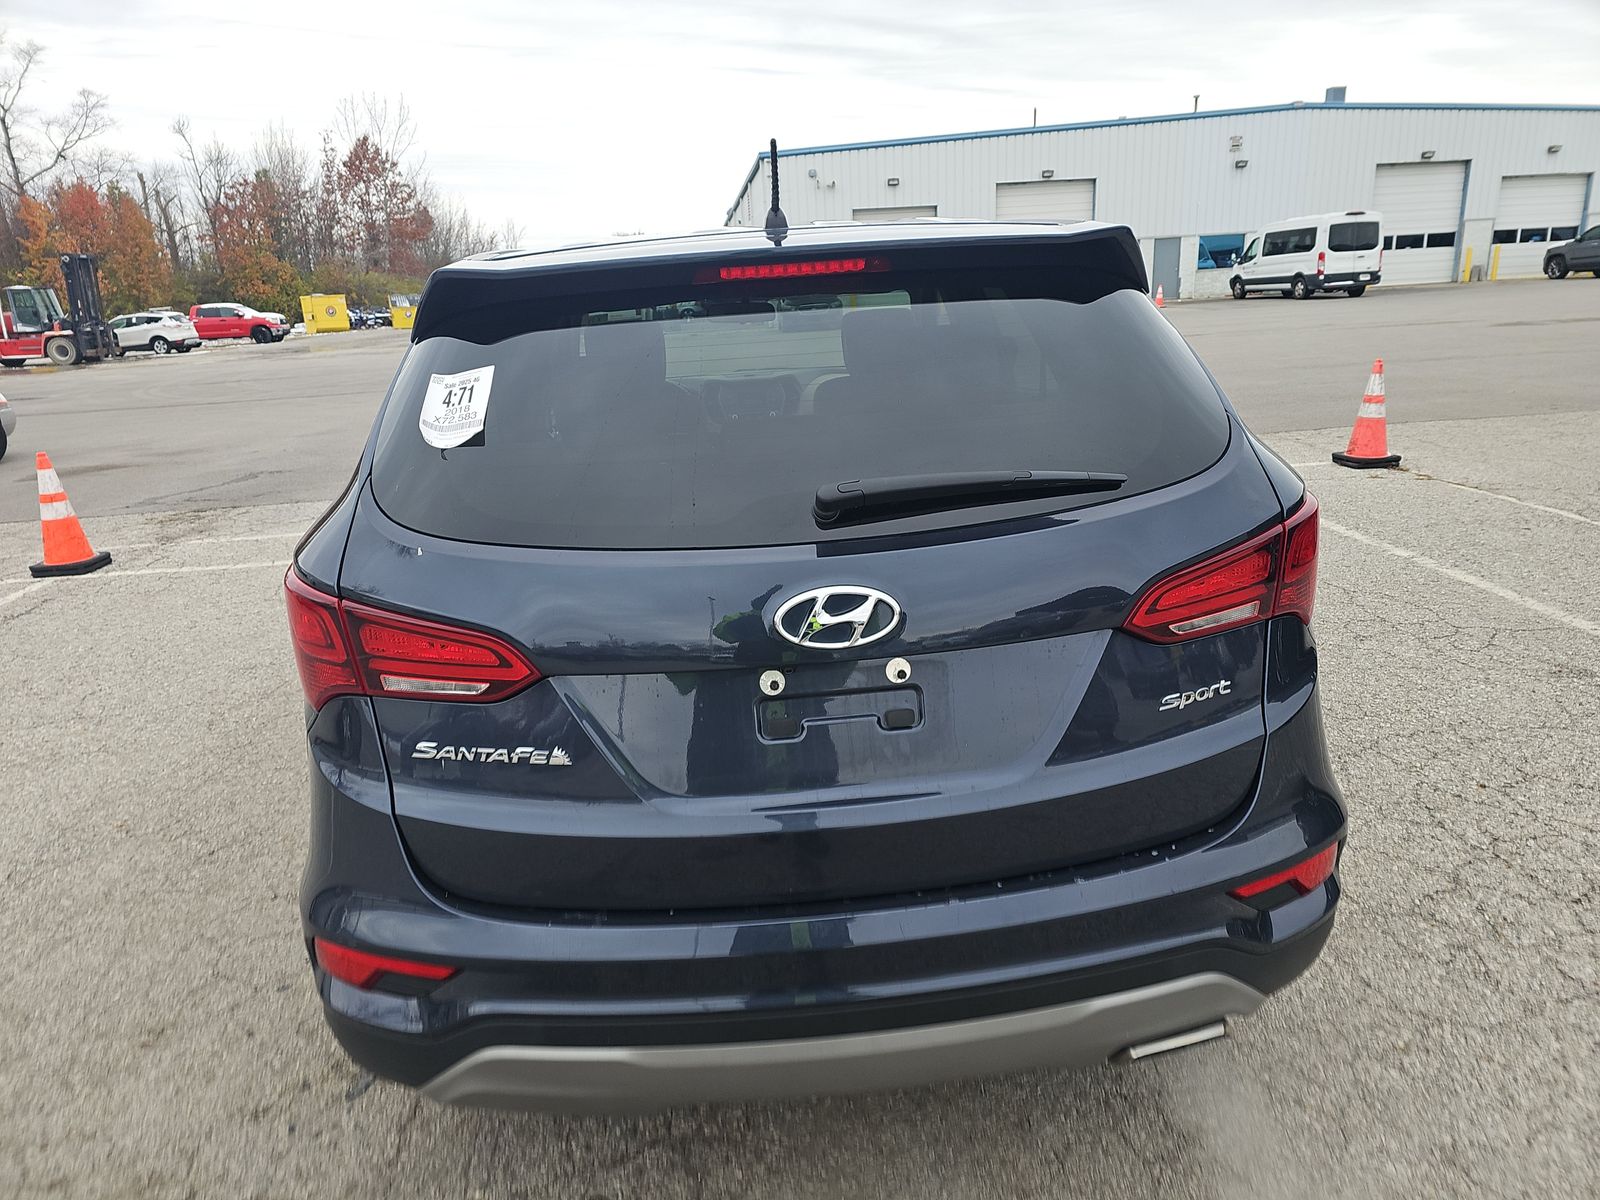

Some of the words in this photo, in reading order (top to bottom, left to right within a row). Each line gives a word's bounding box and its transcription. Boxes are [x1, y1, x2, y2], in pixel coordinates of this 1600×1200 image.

[442, 384, 475, 408] 4:71
[445, 405, 471, 416] 2018
[1159, 679, 1231, 711] Sport
